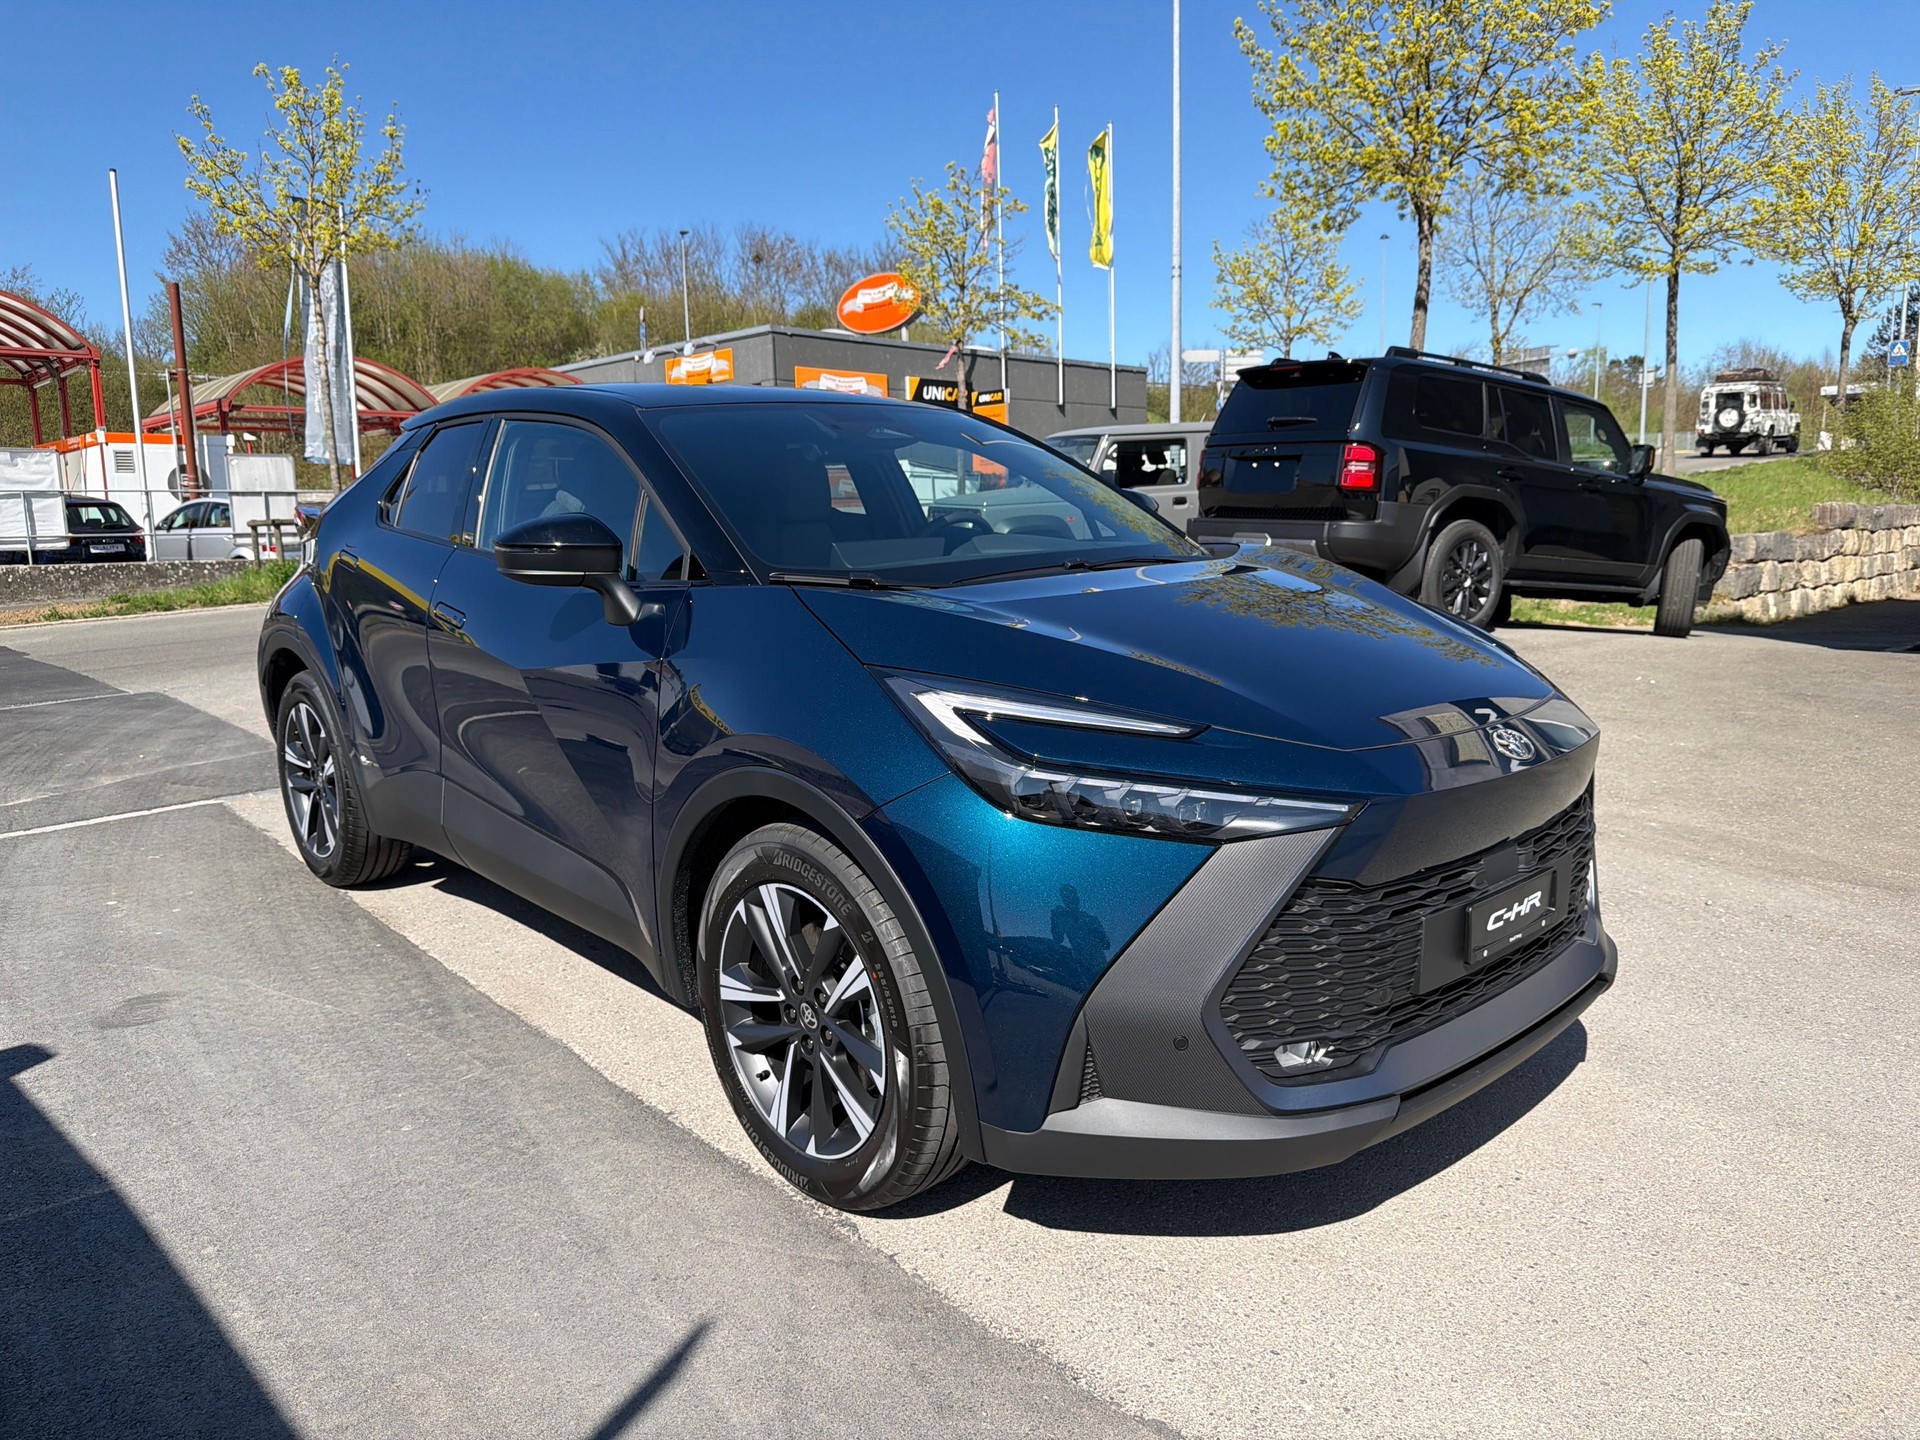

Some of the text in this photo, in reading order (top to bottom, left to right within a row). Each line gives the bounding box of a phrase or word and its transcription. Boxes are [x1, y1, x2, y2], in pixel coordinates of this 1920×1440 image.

[772, 848, 853, 916] BRIDGESTONE
[1486, 890, 1542, 932] C-HR
[740, 1113, 810, 1191] BRIDGESTONE
